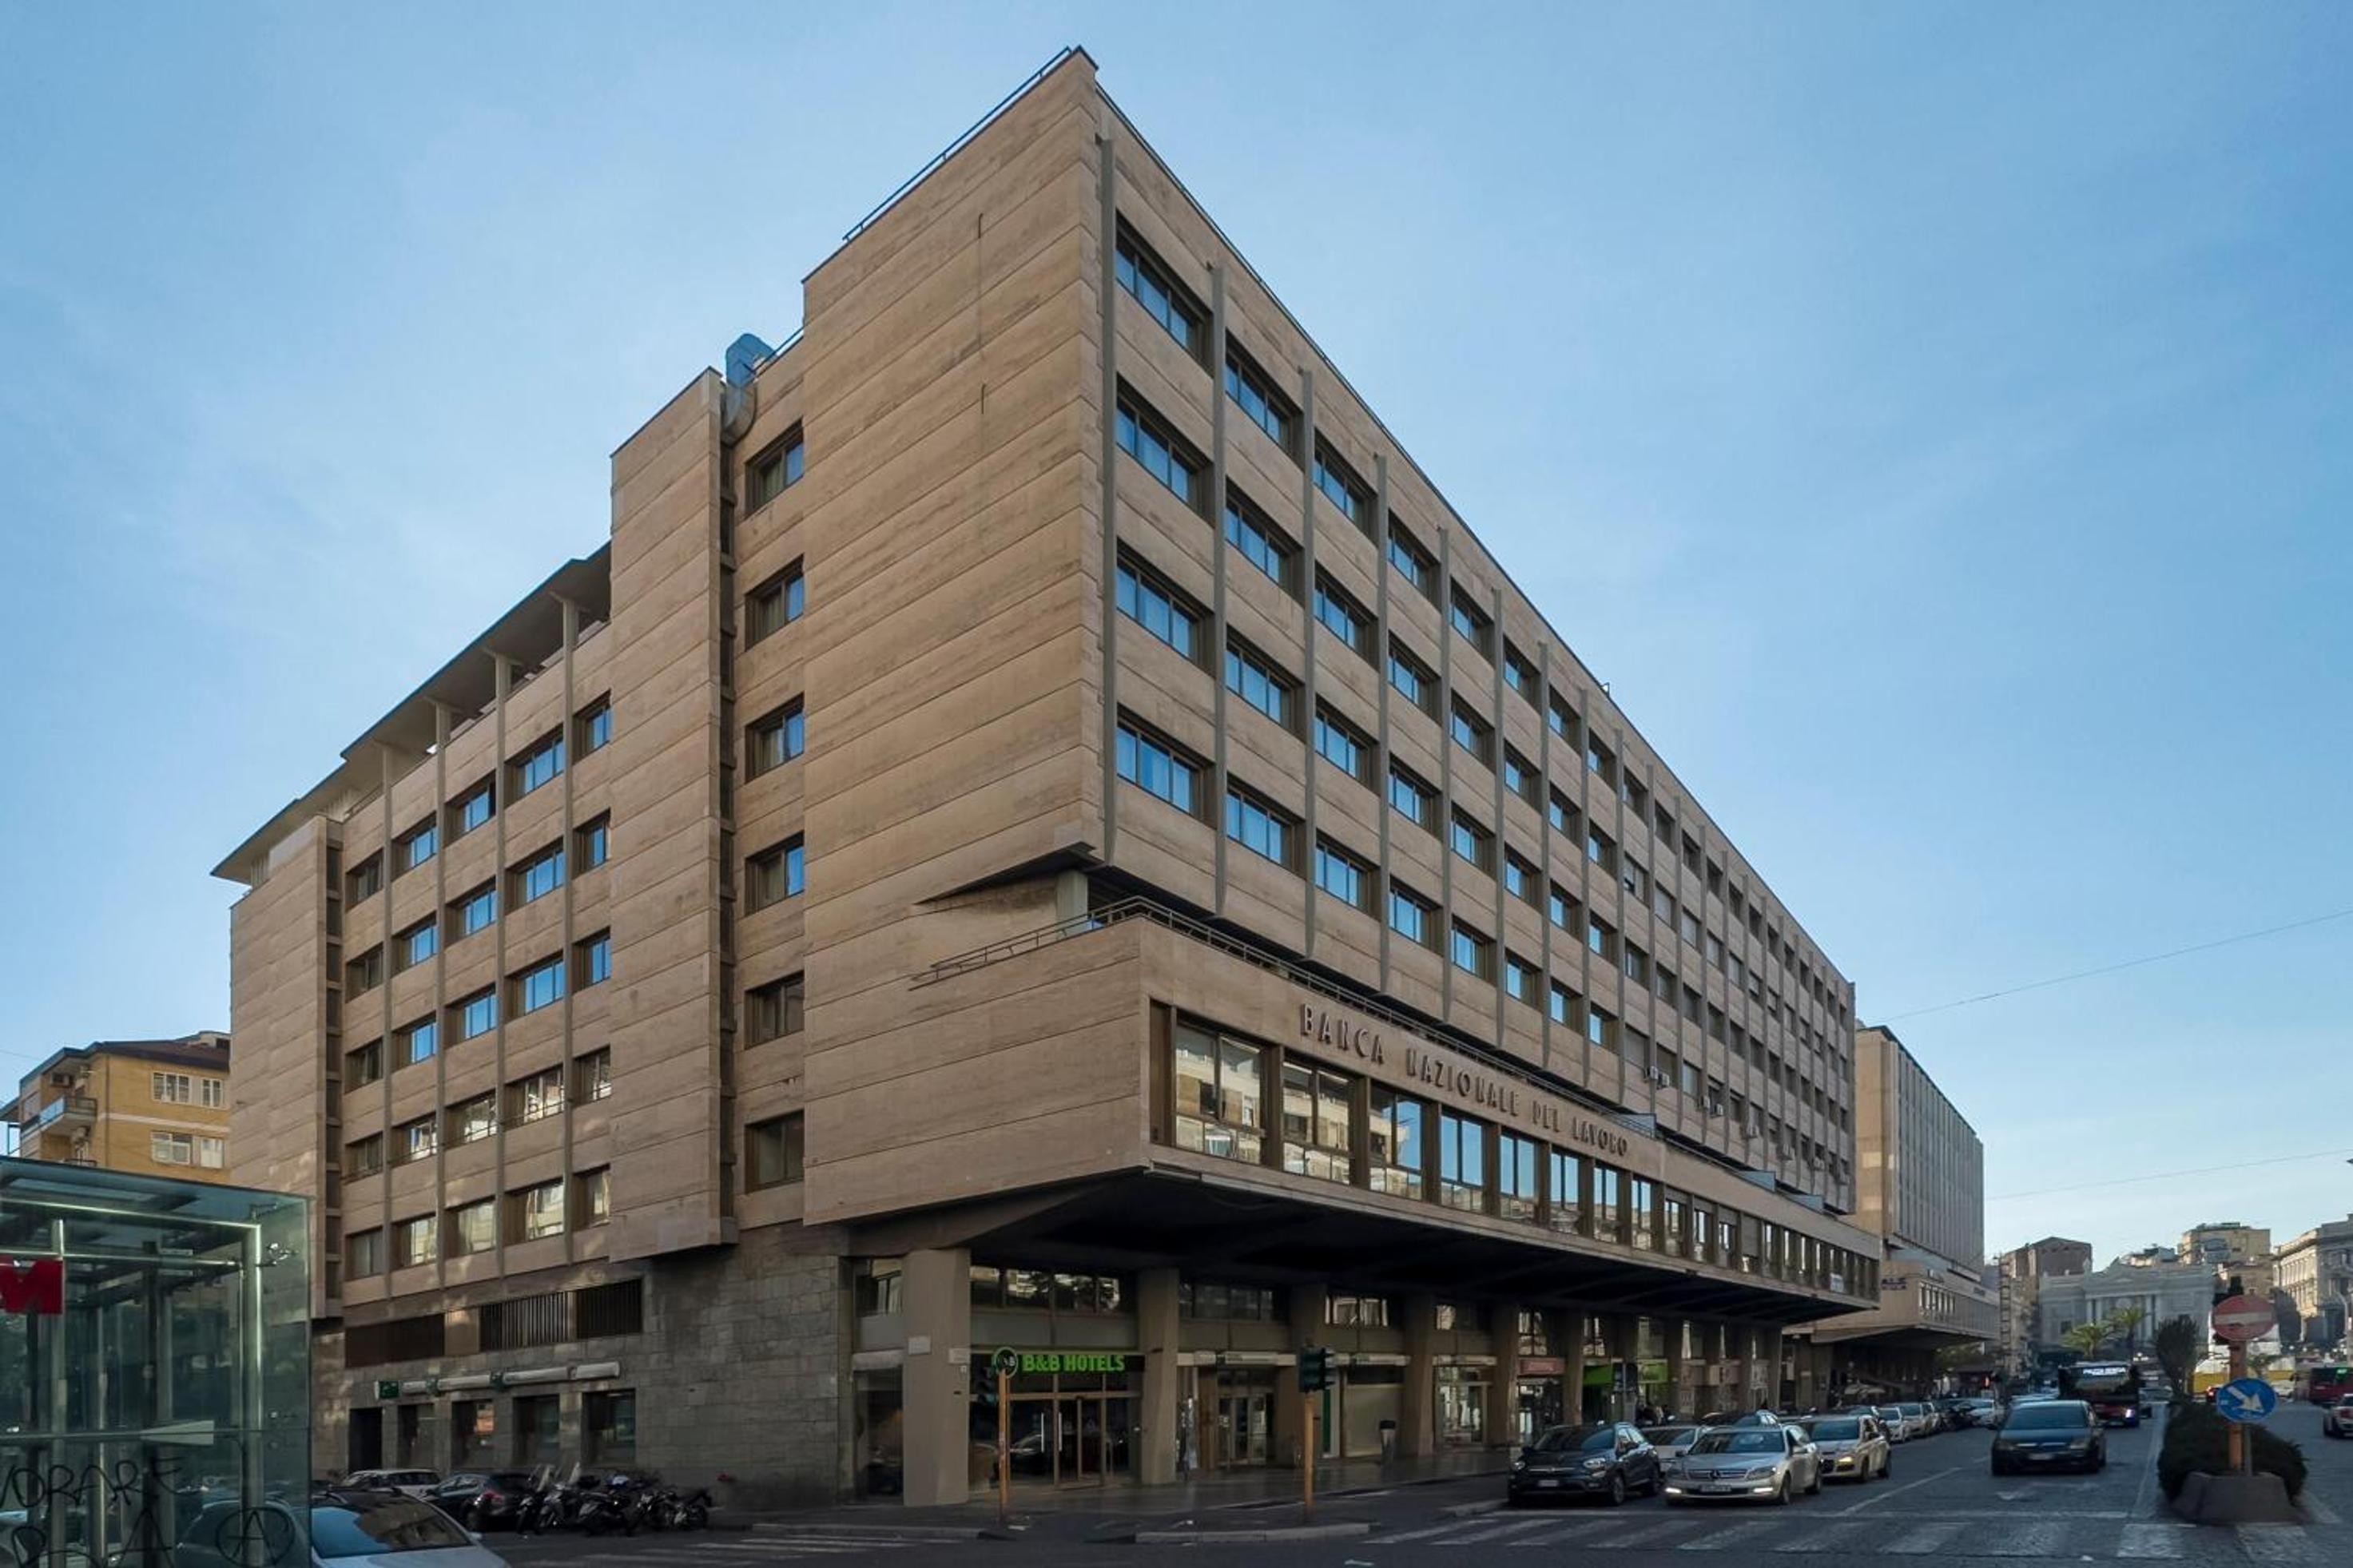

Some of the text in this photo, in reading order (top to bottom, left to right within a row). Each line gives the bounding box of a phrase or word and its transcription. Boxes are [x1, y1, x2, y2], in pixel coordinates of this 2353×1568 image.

[1301, 1003, 1628, 1156] BANCA NAZIONALE DEL LAVORO
[1023, 1355, 1126, 1373] B&B HOTELS
